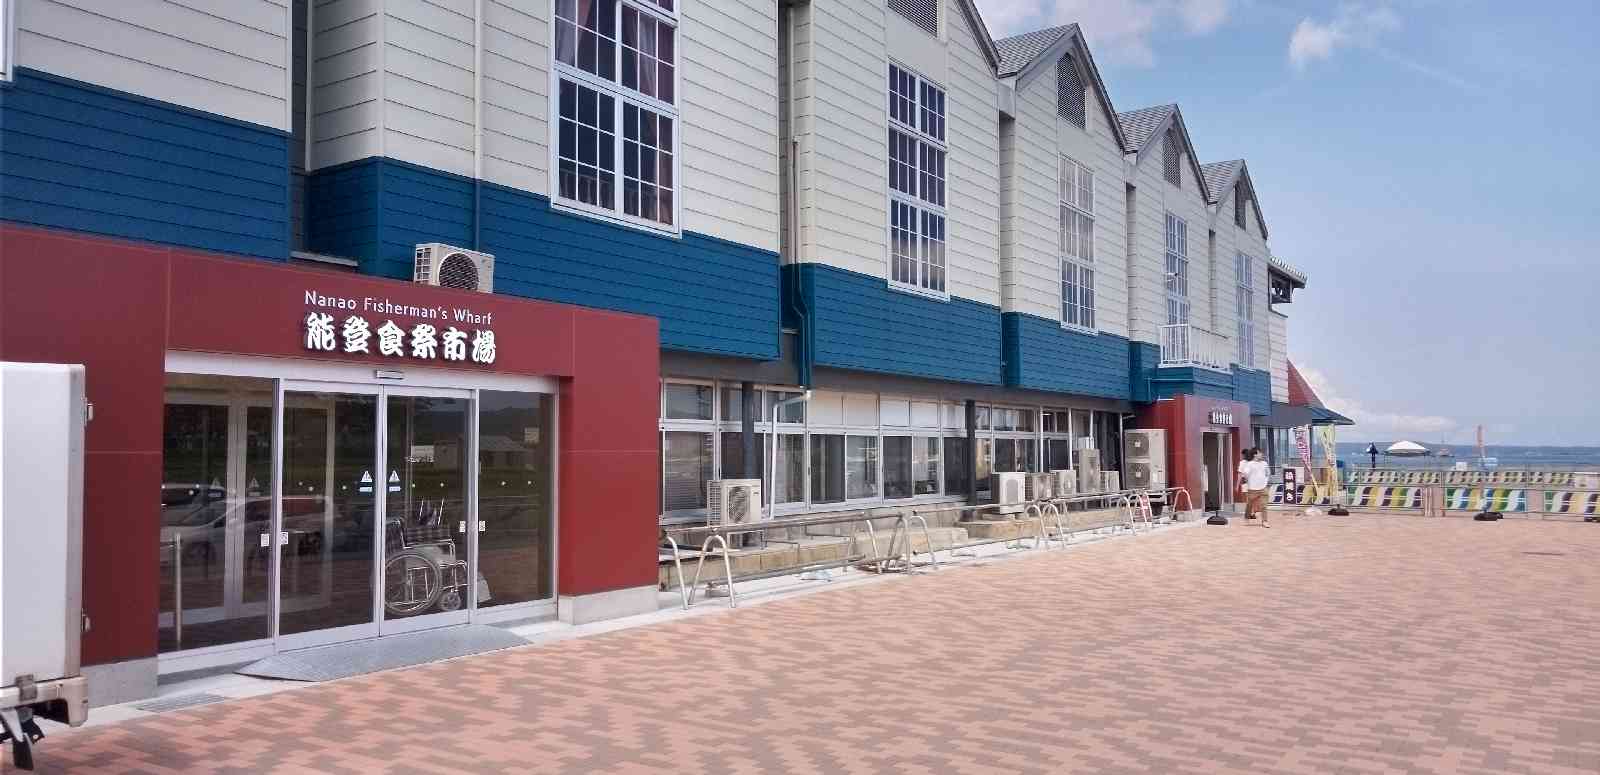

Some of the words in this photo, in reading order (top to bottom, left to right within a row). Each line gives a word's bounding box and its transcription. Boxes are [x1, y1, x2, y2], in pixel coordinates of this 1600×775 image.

[304, 290, 357, 310] Nanao
[363, 297, 448, 320] Fisherman's
[453, 307, 492, 325] Wharf
[306, 311, 497, 364] 能登食祭市場
